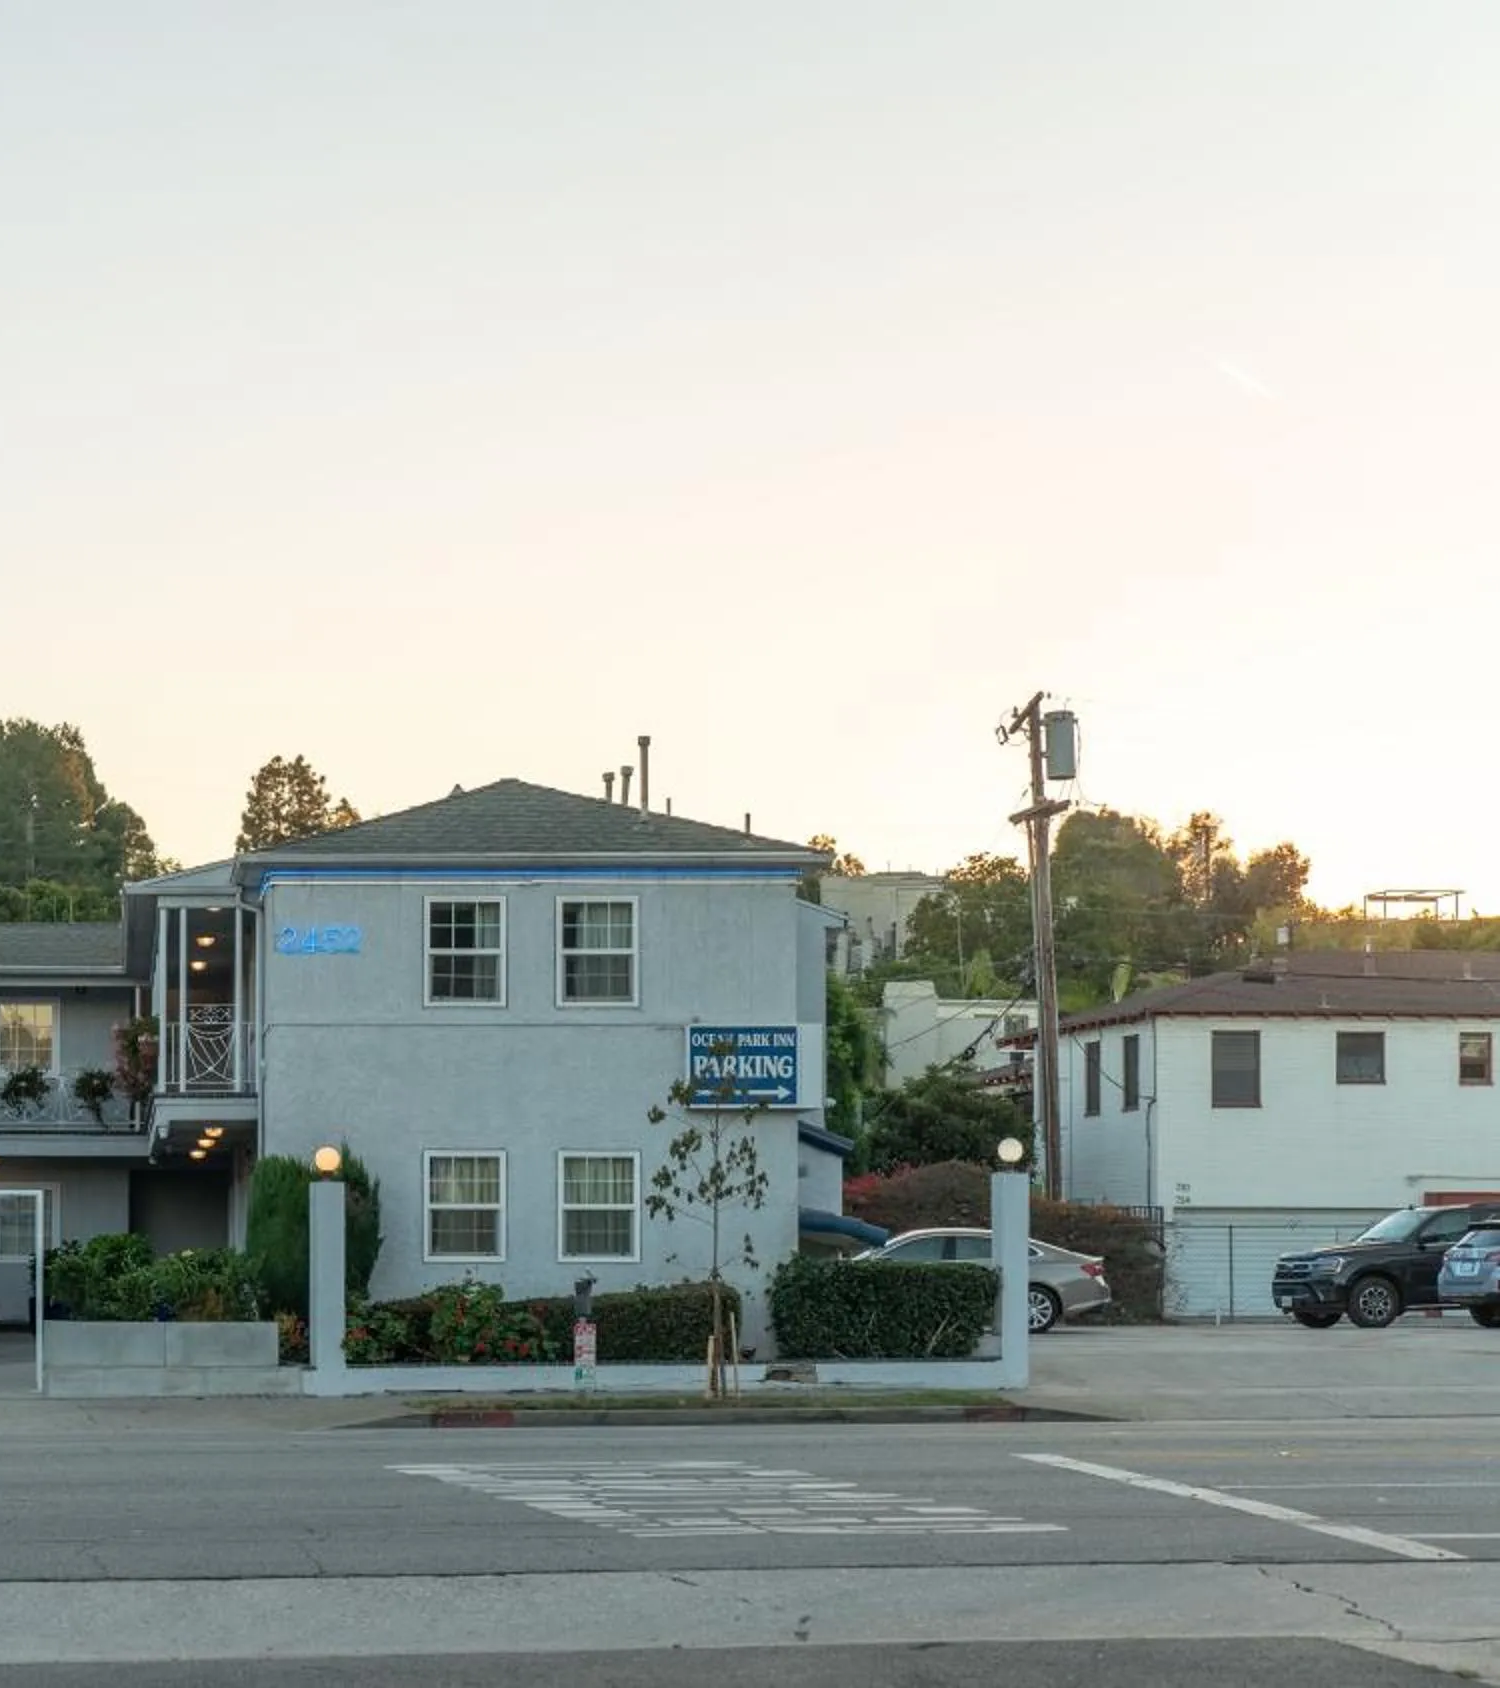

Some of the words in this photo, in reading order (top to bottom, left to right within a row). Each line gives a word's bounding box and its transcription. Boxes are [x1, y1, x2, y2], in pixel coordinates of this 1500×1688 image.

[737, 1033, 770, 1047] PARK
[773, 1033, 795, 1047] INN
[692, 1055, 794, 1079] PARKING
